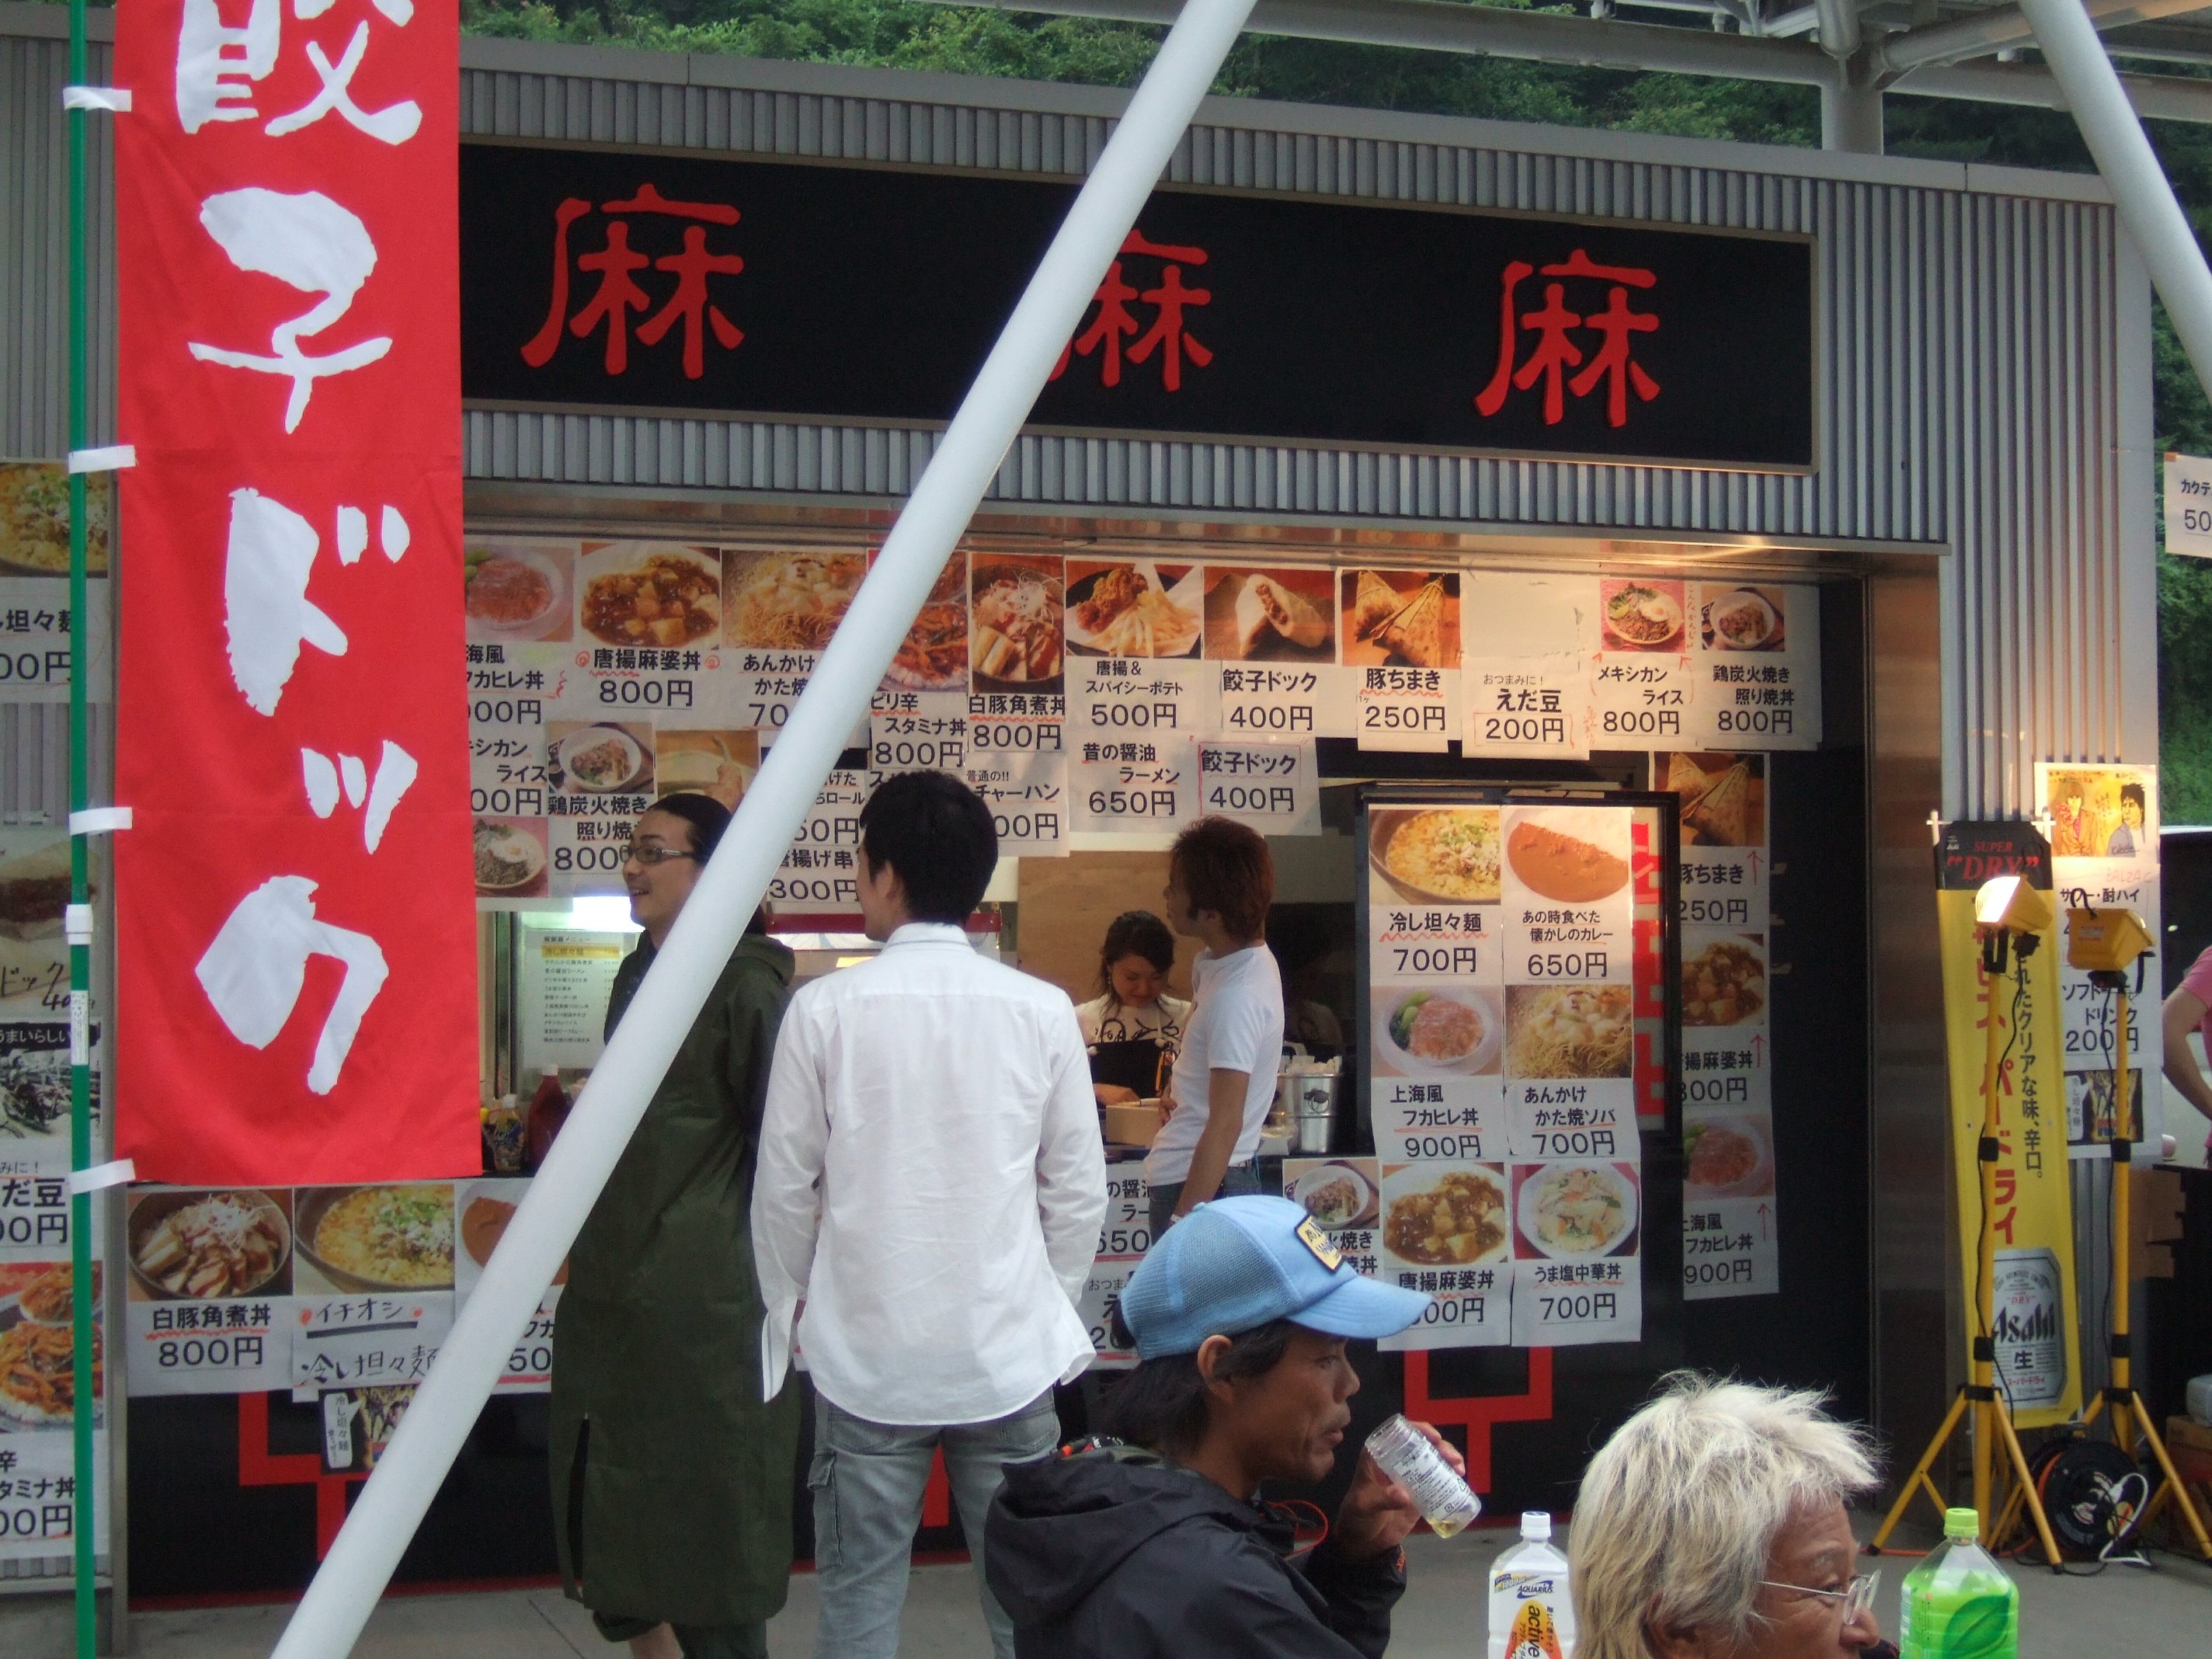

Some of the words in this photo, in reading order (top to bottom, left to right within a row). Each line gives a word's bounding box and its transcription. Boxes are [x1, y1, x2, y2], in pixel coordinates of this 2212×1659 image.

[520, 183, 744, 380] 麻
[1046, 229, 1213, 392] 麻
[1473, 249, 1661, 428] 麻
[2181, 479, 2212, 496] カクテ
[594, 649, 701, 671] 唐揚麻婆丼
[743, 654, 815, 672] あんかけ
[466, 670, 544, 690] カヒレ丼
[1223, 670, 1317, 692] 餃子ドック
[1366, 668, 1441, 690] 豚ちまき
[1598, 666, 1668, 683] メキシカン
[1713, 666, 1790, 683] 鶏炭火焼き
[600, 680, 693, 707] 800円
[871, 694, 919, 711] ピリ辛
[1497, 689, 1562, 713] えだ豆
[1643, 689, 1684, 705] ライス
[1735, 688, 1795, 706] 照り焼丼
[466, 700, 542, 725] 00円
[969, 694, 1066, 716] 白豚角煮丼
[1091, 703, 1177, 729] 500円
[885, 718, 967, 736] スタミナ丼
[1229, 706, 1313, 731] 400円
[1365, 705, 1445, 731] 250円
[1603, 710, 1680, 735] 800円
[1718, 710, 1793, 735] 800円
[974, 724, 1061, 750] 800円
[1486, 718, 1563, 743] 200円
[875, 741, 963, 767] 800円
[1083, 743, 1156, 762] 昔の醤油
[1202, 750, 1296, 775] 餃子ドック
[497, 764, 548, 783] ライス
[1119, 767, 1181, 784] ラーメン
[975, 784, 1060, 802] チャーハン
[1089, 790, 1175, 816] 650円
[1209, 787, 1295, 812] 400円
[548, 796, 648, 816] 鶏炭火焼き
[577, 822, 639, 840] 照り焼
[1974, 841, 2013, 852] SUPER
[770, 879, 860, 903] 300円
[1389, 912, 1481, 932] 冷し坦々麺
[1522, 909, 1601, 924] あの時食べた
[1530, 927, 1613, 942] 懐かしのカレー
[1393, 948, 1476, 973] 700円
[1528, 952, 1608, 977] 650円
[1682, 1050, 1752, 1071] 揚麻婆丼
[1390, 1085, 1444, 1103] 上海風
[1525, 1086, 1587, 1104] あんかけ
[1403, 1108, 1479, 1126] フカヒレ丼
[1536, 1108, 1616, 1127] かた焼ソバ
[1405, 1135, 1481, 1158] 900円
[1532, 1130, 1615, 1156] 700円
[0, 1213, 68, 1243] 0円
[1685, 1233, 1754, 1254] フカヒレ丼
[1536, 1263, 1621, 1283] うま塩中華丼
[1685, 1259, 1751, 1284] 900円
[152, 1303, 271, 1329] 白豚角煮丼
[317, 1298, 402, 1323] イチオシ
[1540, 1293, 1616, 1320] 700円
[158, 1337, 263, 1367] 800円
[2015, 1351, 2034, 1370] 生
[1518, 1581, 1553, 1593] AQUARIUS
[1529, 1605, 1543, 1658] active
